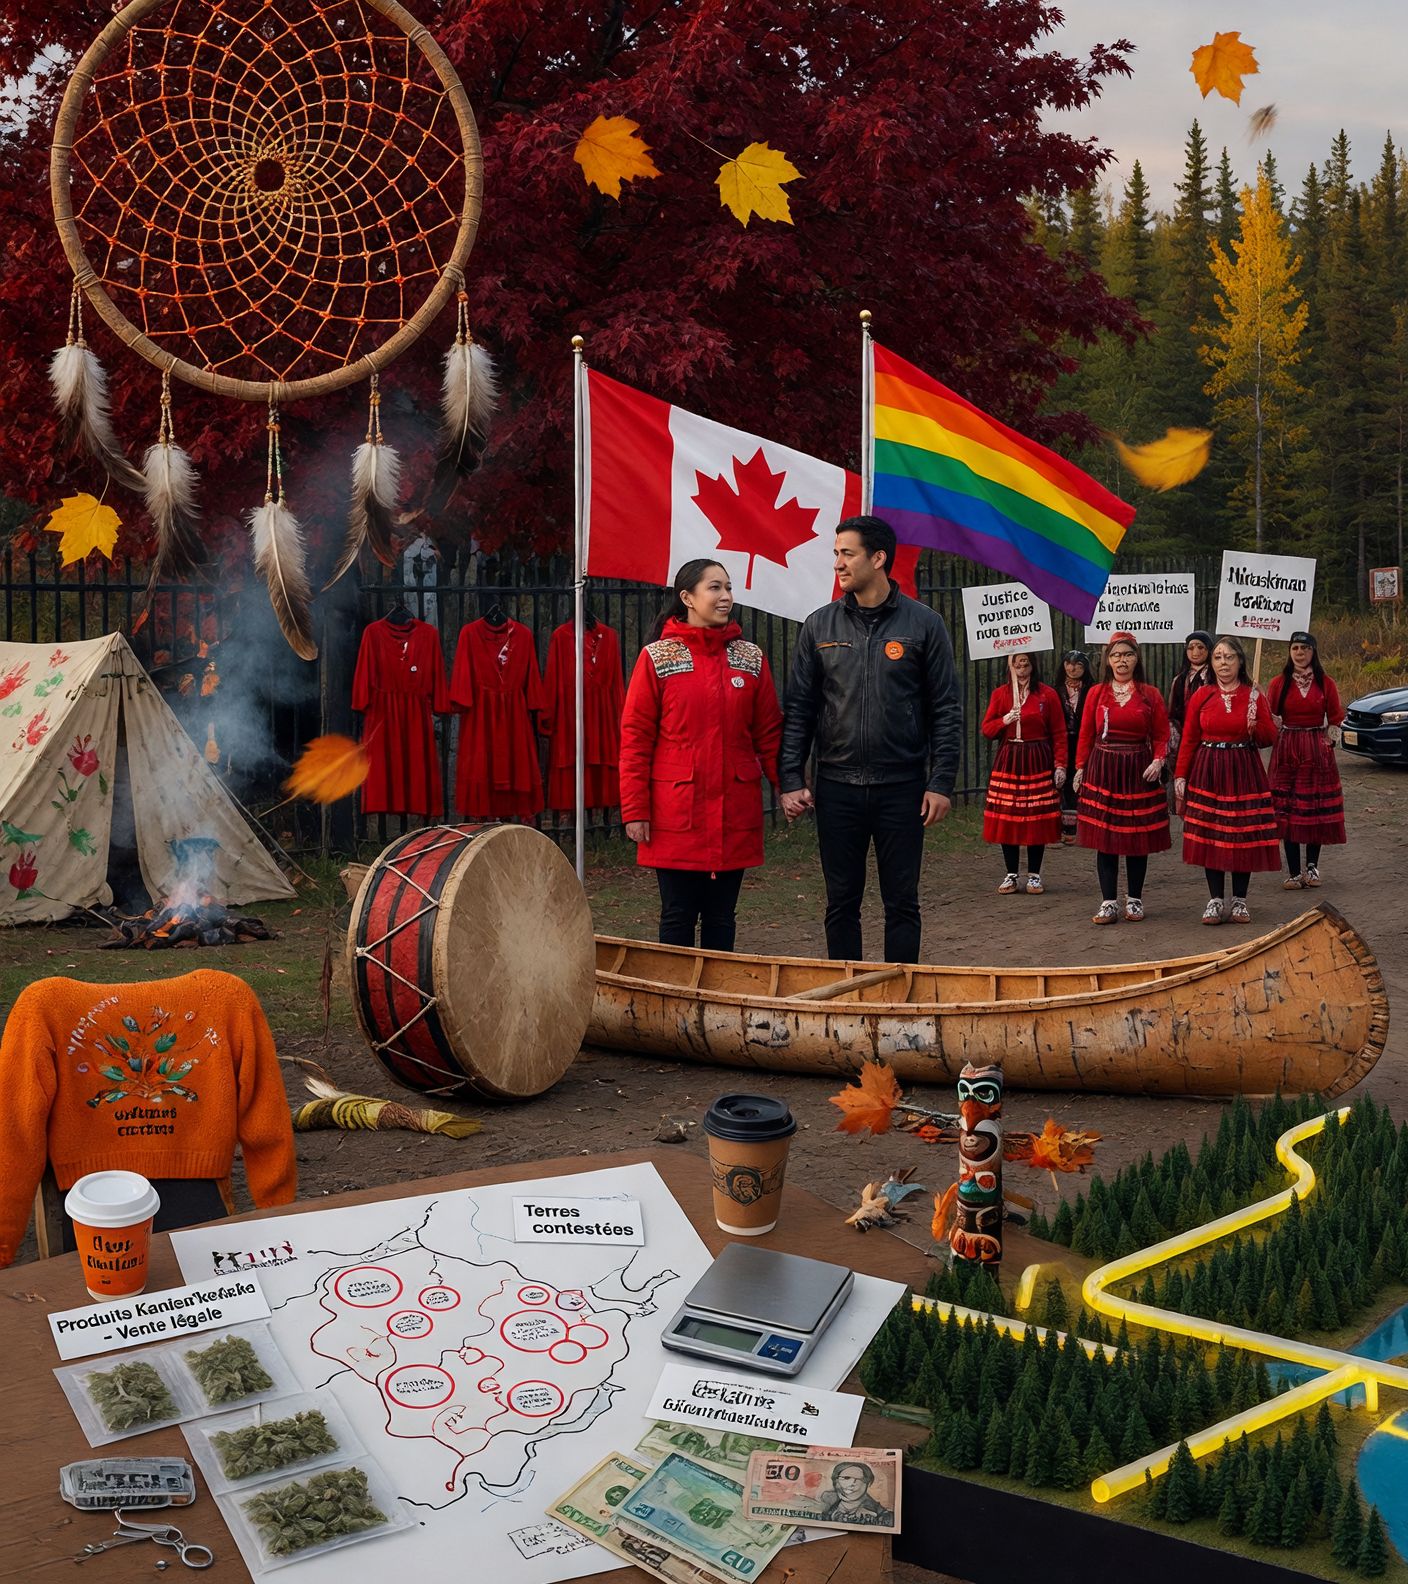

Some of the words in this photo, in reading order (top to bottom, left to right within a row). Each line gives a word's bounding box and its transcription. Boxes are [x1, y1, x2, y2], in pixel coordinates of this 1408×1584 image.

[981, 590, 1029, 607] Justice
[523, 1204, 580, 1218] Terres
[532, 1222, 634, 1236] contestées
[116, 1320, 166, 1340] Vente
